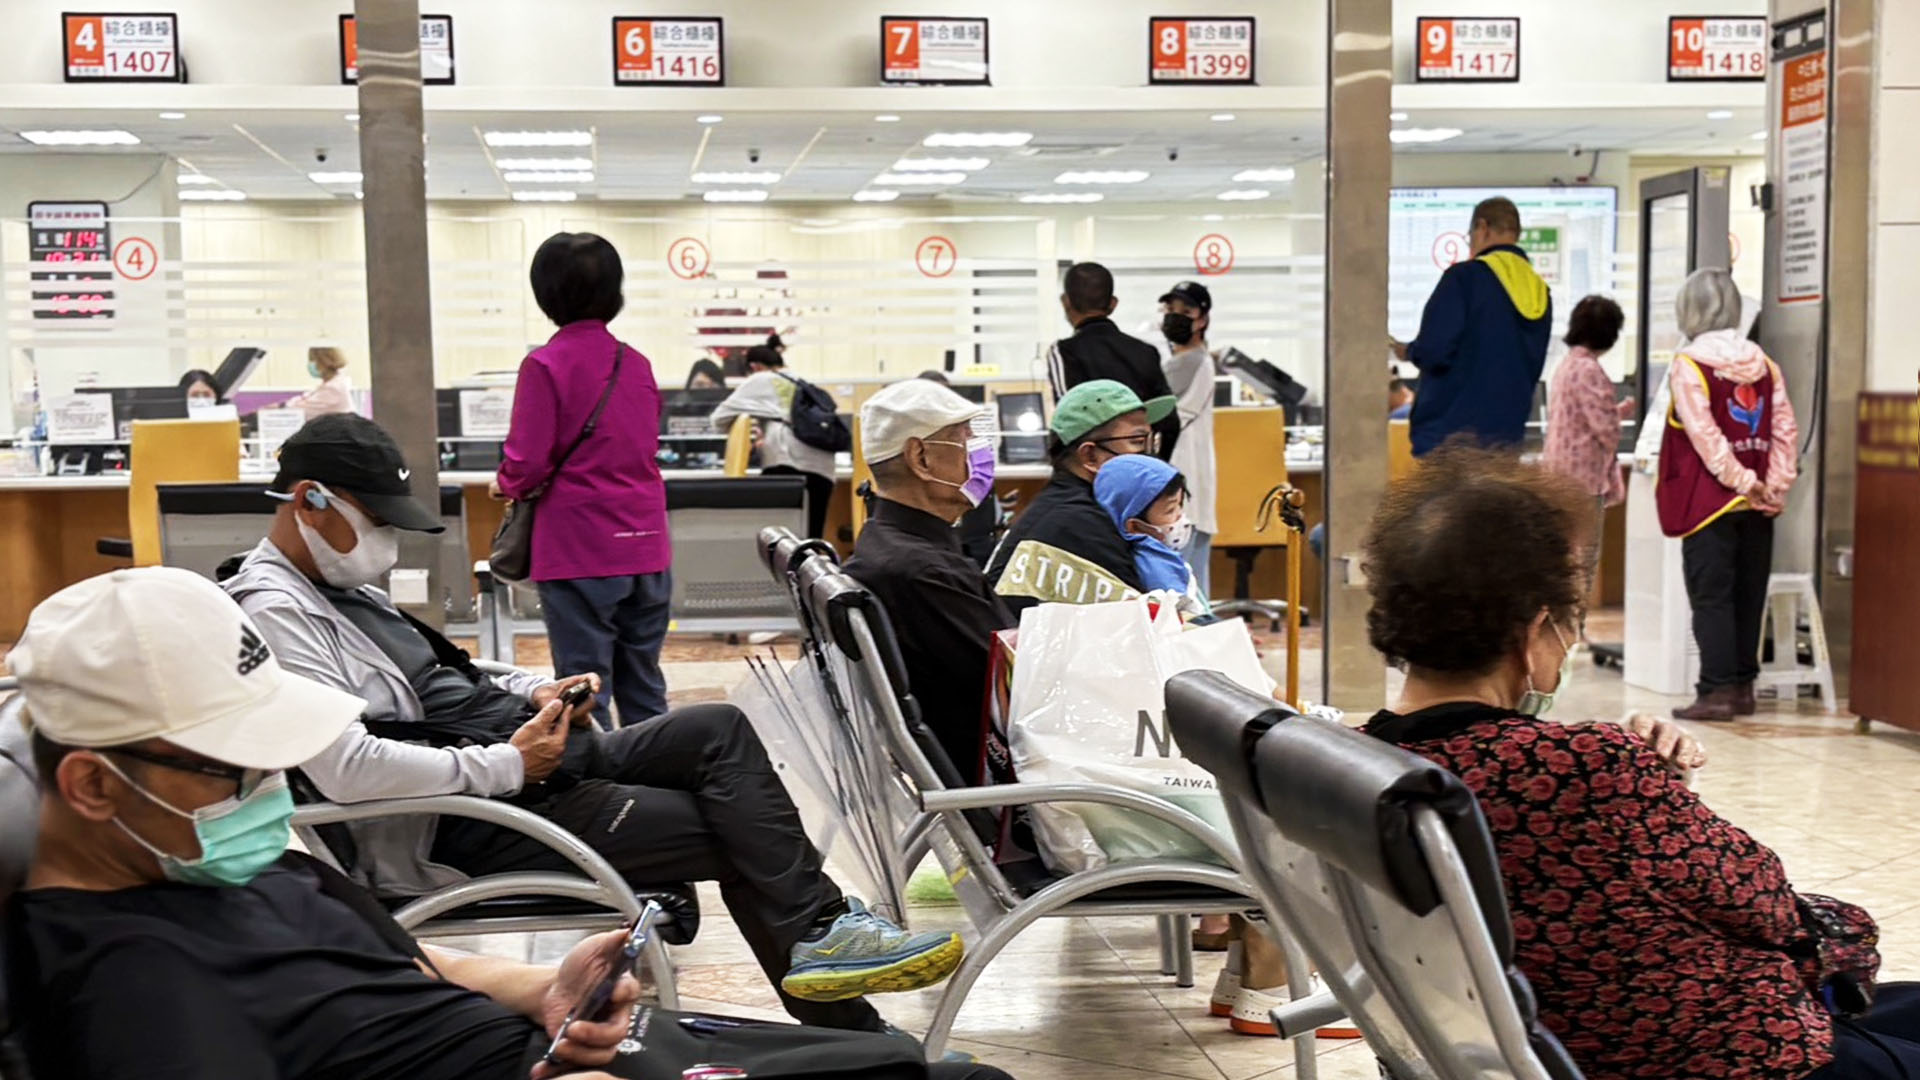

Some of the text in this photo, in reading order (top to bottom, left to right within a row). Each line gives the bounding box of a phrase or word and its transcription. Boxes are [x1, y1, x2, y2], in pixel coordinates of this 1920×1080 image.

[75, 22, 97, 52] 4
[625, 27, 646, 57] 6
[891, 26, 913, 55] 7
[1160, 26, 1180, 56] 8
[1427, 25, 1447, 54] 9
[1673, 27, 1704, 52] 10
[107, 51, 172, 73] 1407
[655, 55, 718, 77] 1416
[1189, 54, 1248, 76] 1399
[1456, 52, 1514, 73] 1417
[1707, 52, 1763, 72] 1418
[127, 246, 144, 271] 4
[681, 246, 697, 270] 6
[928, 245, 944, 269] 7
[1206, 242, 1222, 268] 8
[1444, 239, 1458, 264] 9
[1134, 709, 1184, 758] N
[1163, 776, 1215, 789] TAIWA
